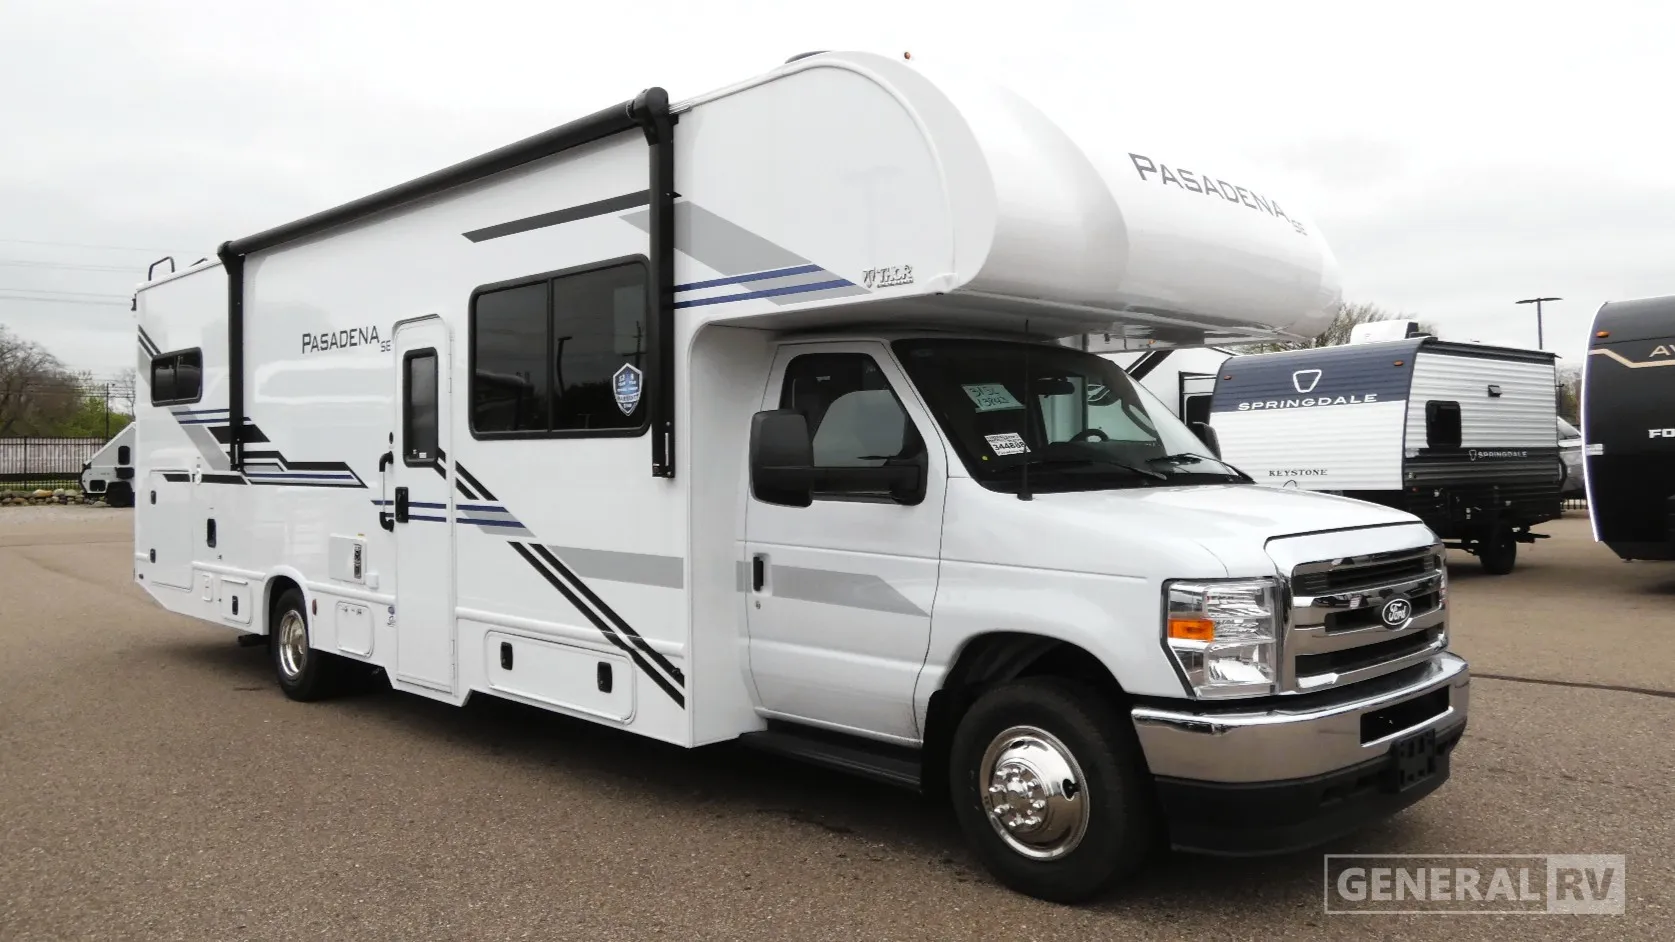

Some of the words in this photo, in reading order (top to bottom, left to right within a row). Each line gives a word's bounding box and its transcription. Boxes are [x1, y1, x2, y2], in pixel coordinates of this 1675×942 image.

[1128, 152, 1290, 222] PASADENA
[302, 325, 380, 354] PASADENA
[380, 340, 391, 352] SE
[1238, 394, 1378, 411] SPRINGDALE
[1269, 469, 1328, 477] KEYSTONE
[1389, 603, 1407, 621] Ford
